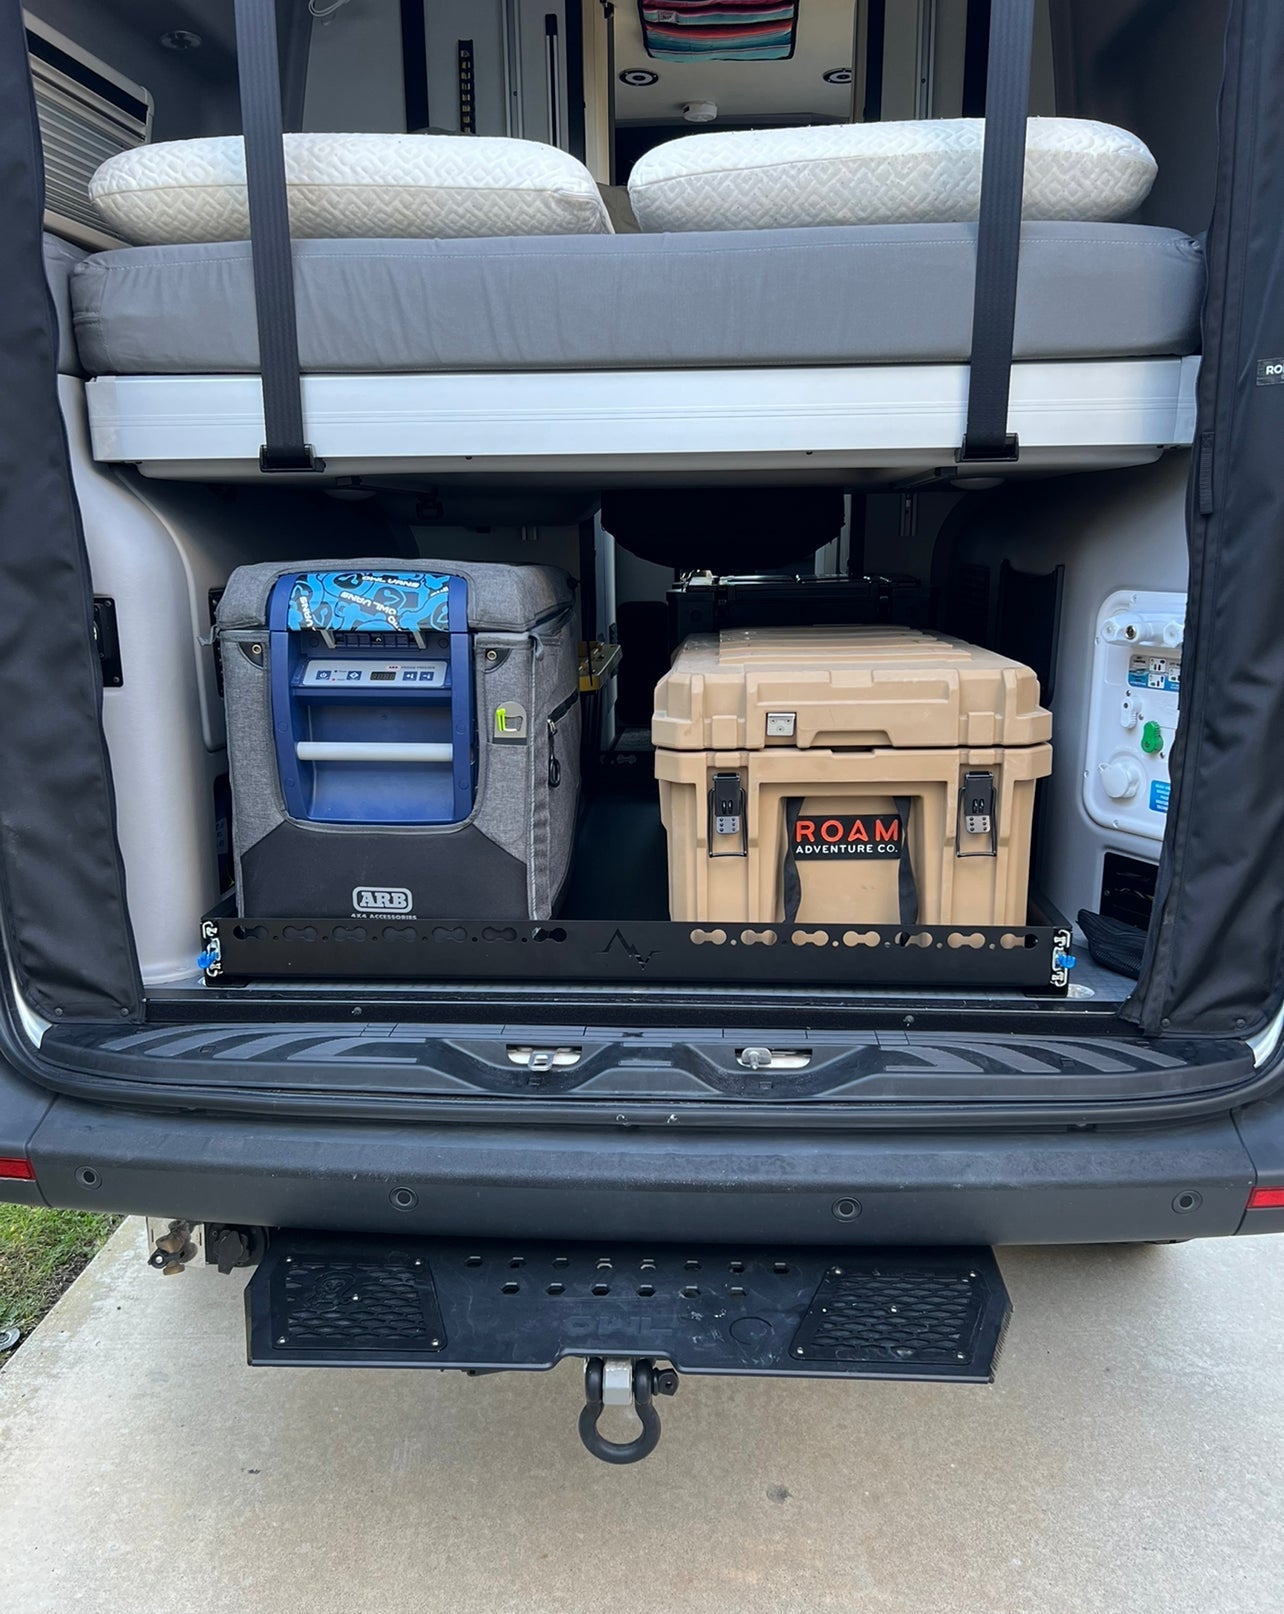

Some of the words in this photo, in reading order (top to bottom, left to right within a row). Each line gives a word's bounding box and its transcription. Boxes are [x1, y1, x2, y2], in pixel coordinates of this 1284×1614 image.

[1266, 365, 1284, 375] RO
[362, 575, 386, 583] OWL
[388, 578, 420, 588] VANS
[340, 591, 371, 607] VANS
[299, 596, 314, 627] VANS
[373, 601, 397, 616] OWL
[796, 819, 899, 842] ROAM
[796, 845, 873, 854] ADVENTURE
[877, 844, 898, 853] CO.
[360, 892, 407, 908] ARB
